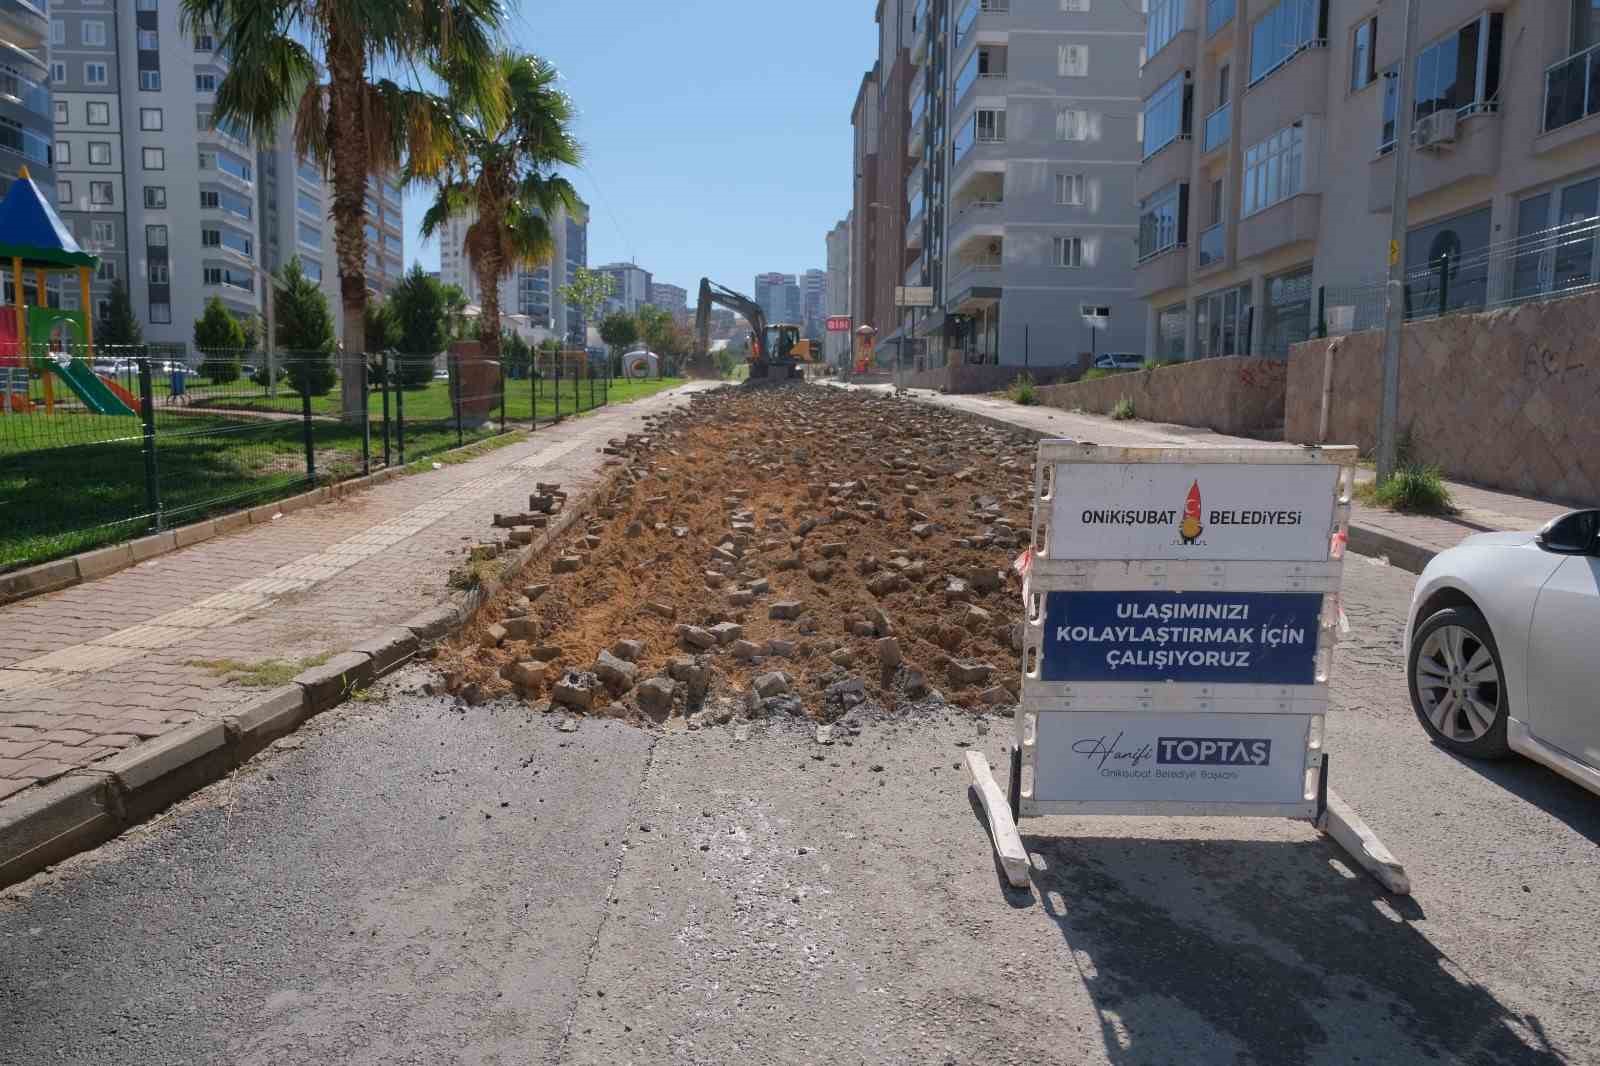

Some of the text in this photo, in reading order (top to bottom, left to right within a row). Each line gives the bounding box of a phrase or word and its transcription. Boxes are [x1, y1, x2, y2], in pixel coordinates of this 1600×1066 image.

[1116, 603, 1249, 623] ULAŞIMINIZI
[1055, 623, 1305, 648] KOLAYLAŞTIRMAK İÇİN
[1106, 649, 1251, 670] ÇALIŞIYORUZ
[1160, 740, 1267, 765] TOPTAŞ
